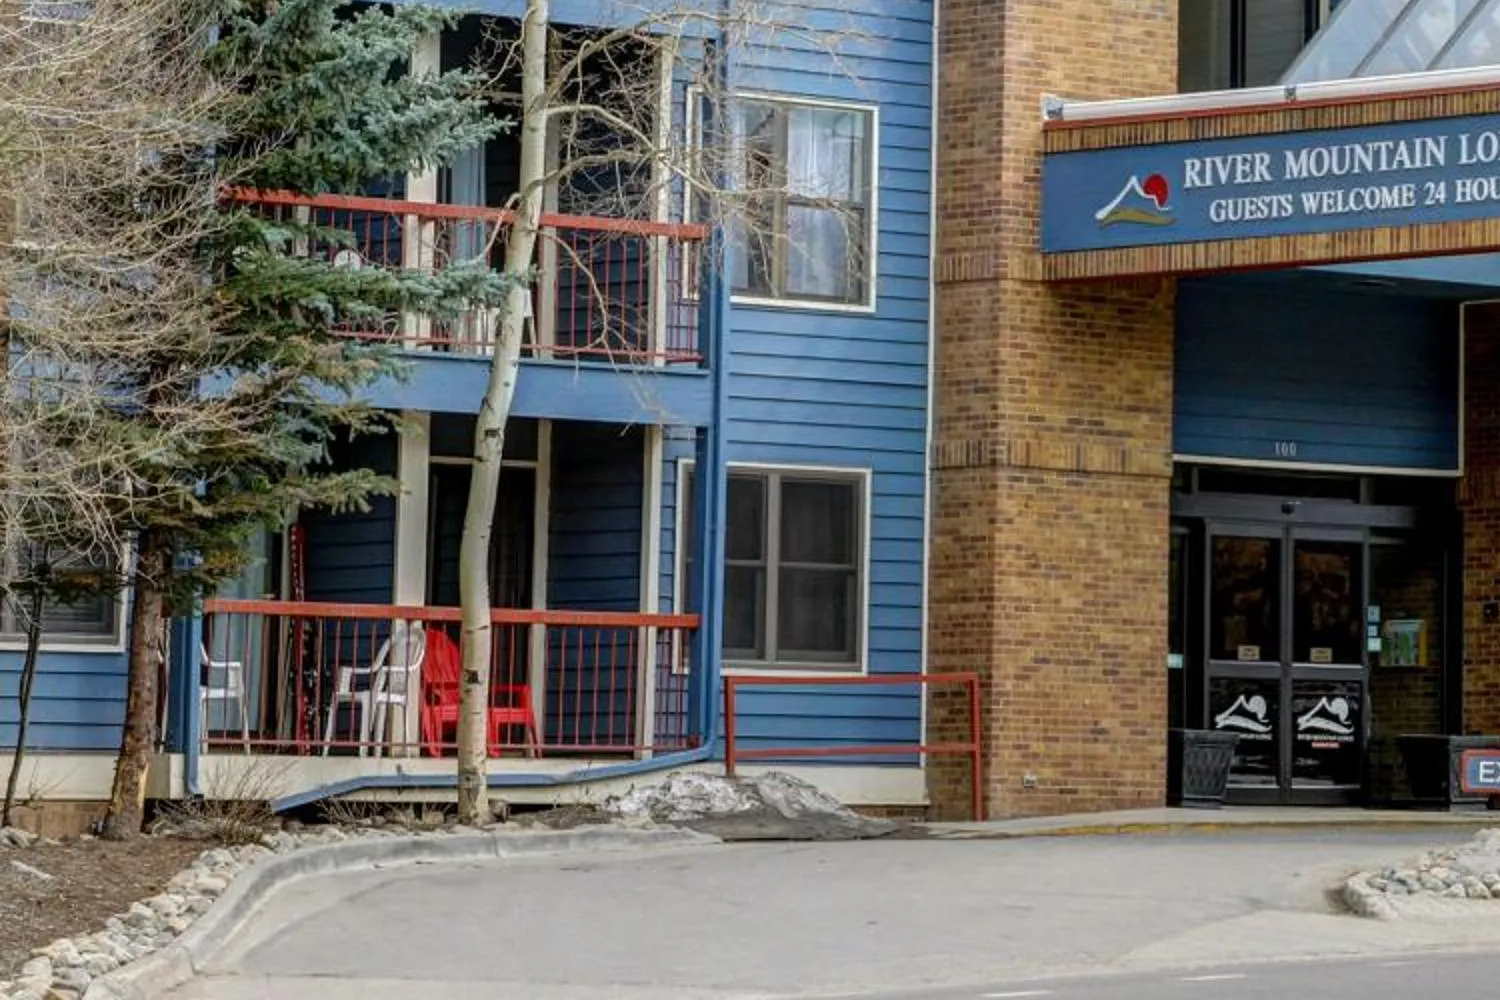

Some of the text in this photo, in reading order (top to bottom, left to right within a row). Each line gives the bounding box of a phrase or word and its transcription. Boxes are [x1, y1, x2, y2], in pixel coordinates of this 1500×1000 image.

[1183, 152, 1272, 189] RIVER
[1284, 135, 1448, 179] MOUNTAIN
[1209, 194, 1294, 223] GUESTS
[1301, 183, 1416, 216] WELCOME
[1424, 181, 1446, 206] 24
[1274, 441, 1297, 457] 100
